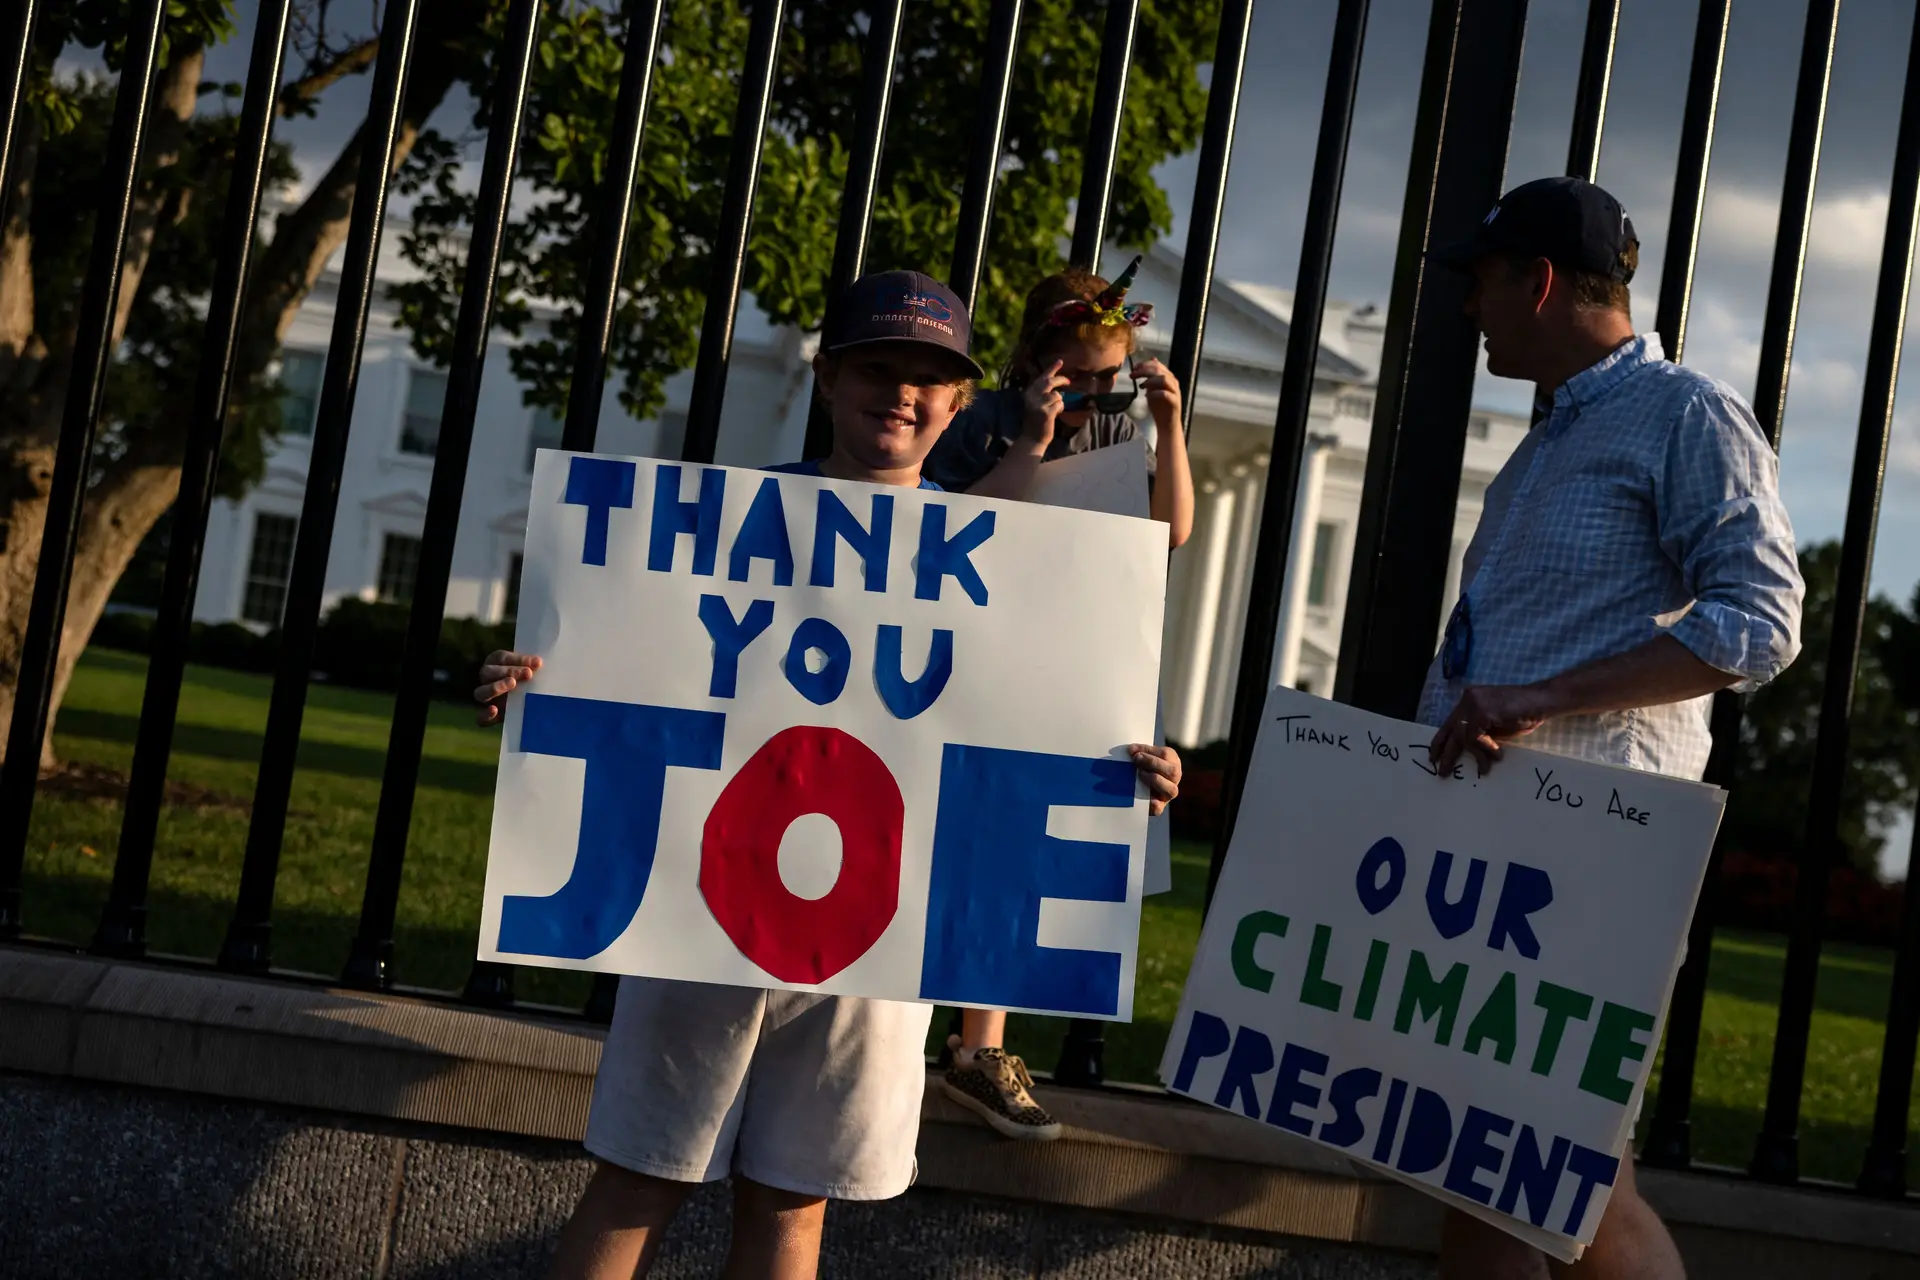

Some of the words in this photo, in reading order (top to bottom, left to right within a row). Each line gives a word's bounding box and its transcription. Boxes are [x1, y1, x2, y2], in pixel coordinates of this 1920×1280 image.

[917, 316, 953, 336] BASEBALL
[564, 457, 996, 606] THANK
[699, 594, 953, 720] YOU
[1408, 744, 1481, 788] JE!
[497, 693, 1135, 1016] JOE
[1356, 836, 1554, 960] OUR
[1231, 910, 1656, 1105] CLIMATE
[1173, 1010, 1619, 1237] PRESIDENT
